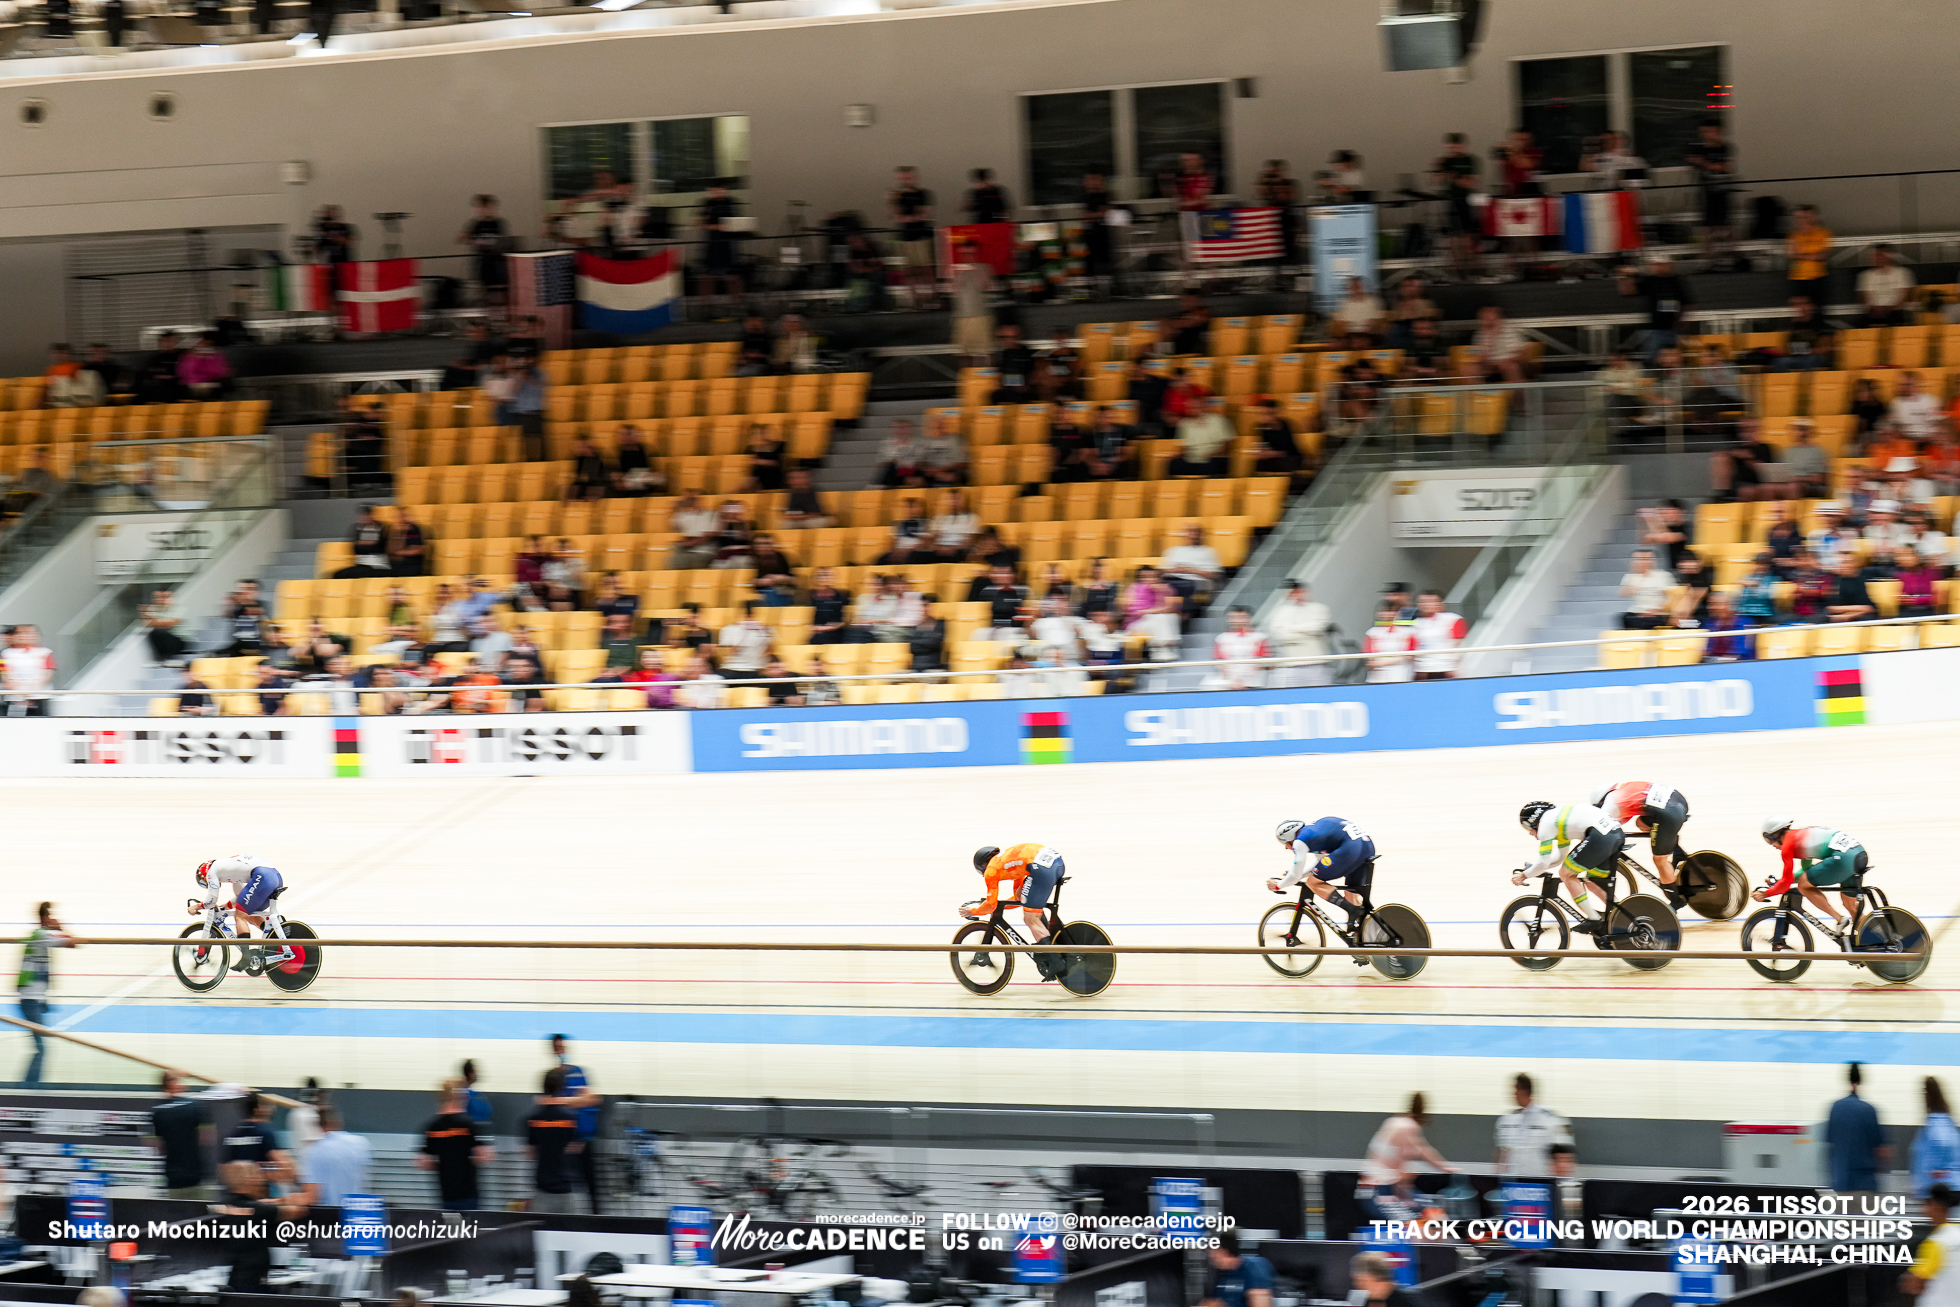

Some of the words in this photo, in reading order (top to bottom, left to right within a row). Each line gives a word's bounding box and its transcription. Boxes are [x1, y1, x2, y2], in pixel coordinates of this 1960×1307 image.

[1493, 679, 1755, 729] SHIMANO
[739, 717, 970, 758] SHIMANO
[1124, 701, 1370, 746] SHIMANO
[131, 730, 291, 764] TISSOT
[472, 725, 645, 763] TISSOT
[243, 874, 263, 905] JAPAN
[1303, 897, 1345, 934] LOOK
